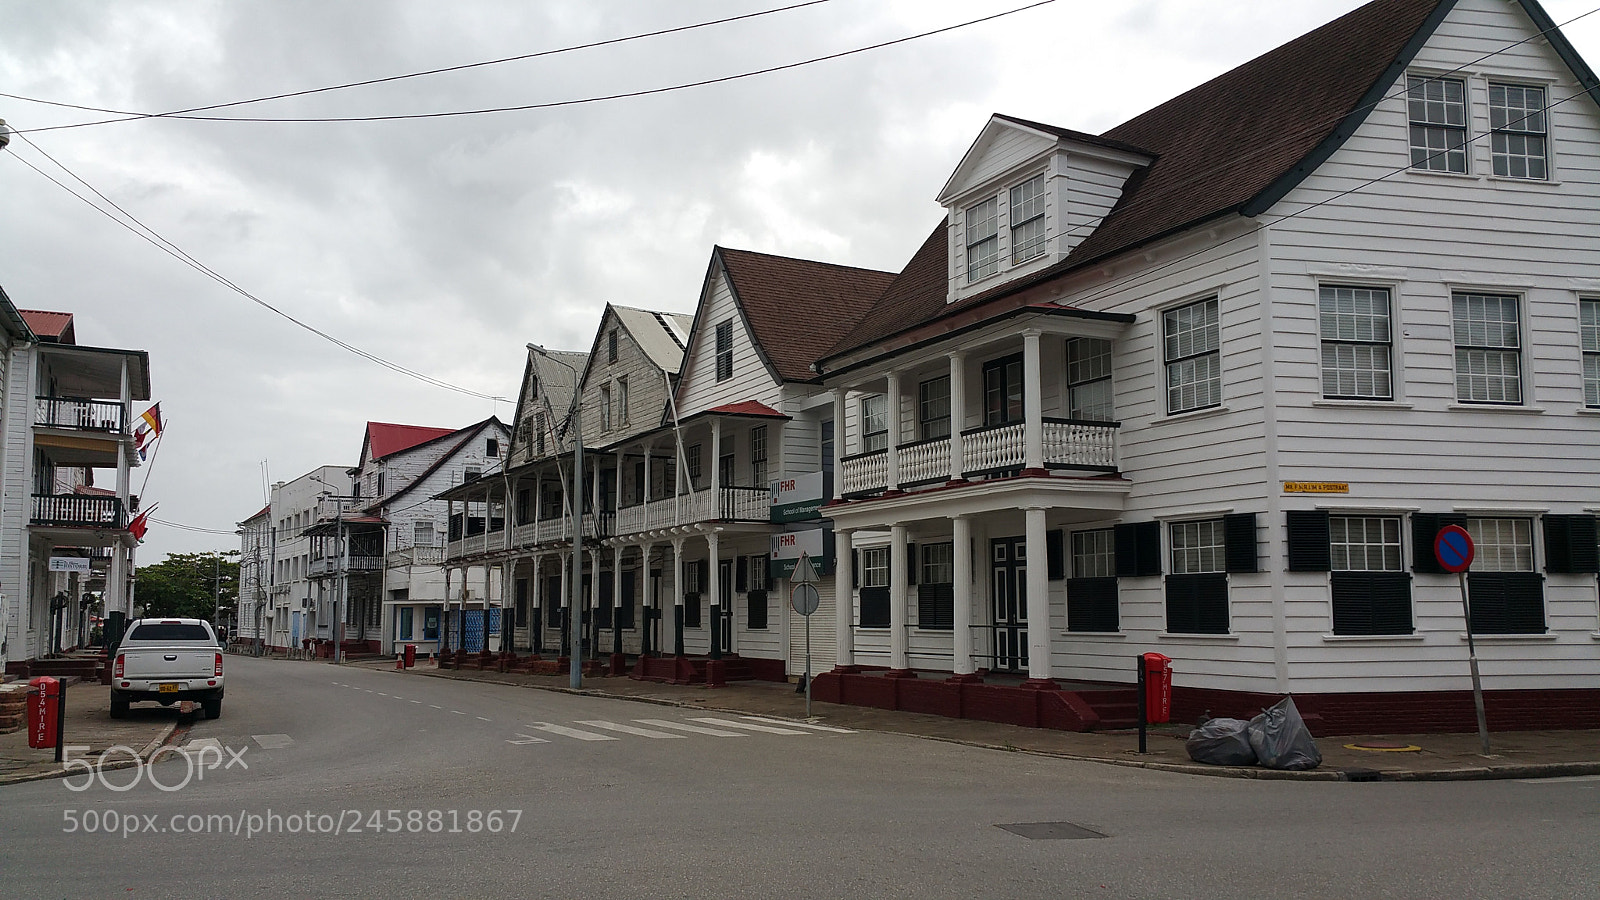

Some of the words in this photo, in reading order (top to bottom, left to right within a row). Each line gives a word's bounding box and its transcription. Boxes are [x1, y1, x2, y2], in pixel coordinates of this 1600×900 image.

[780, 480, 796, 492] FHR
[783, 507, 795, 516] School
[780, 534, 796, 547] FHR
